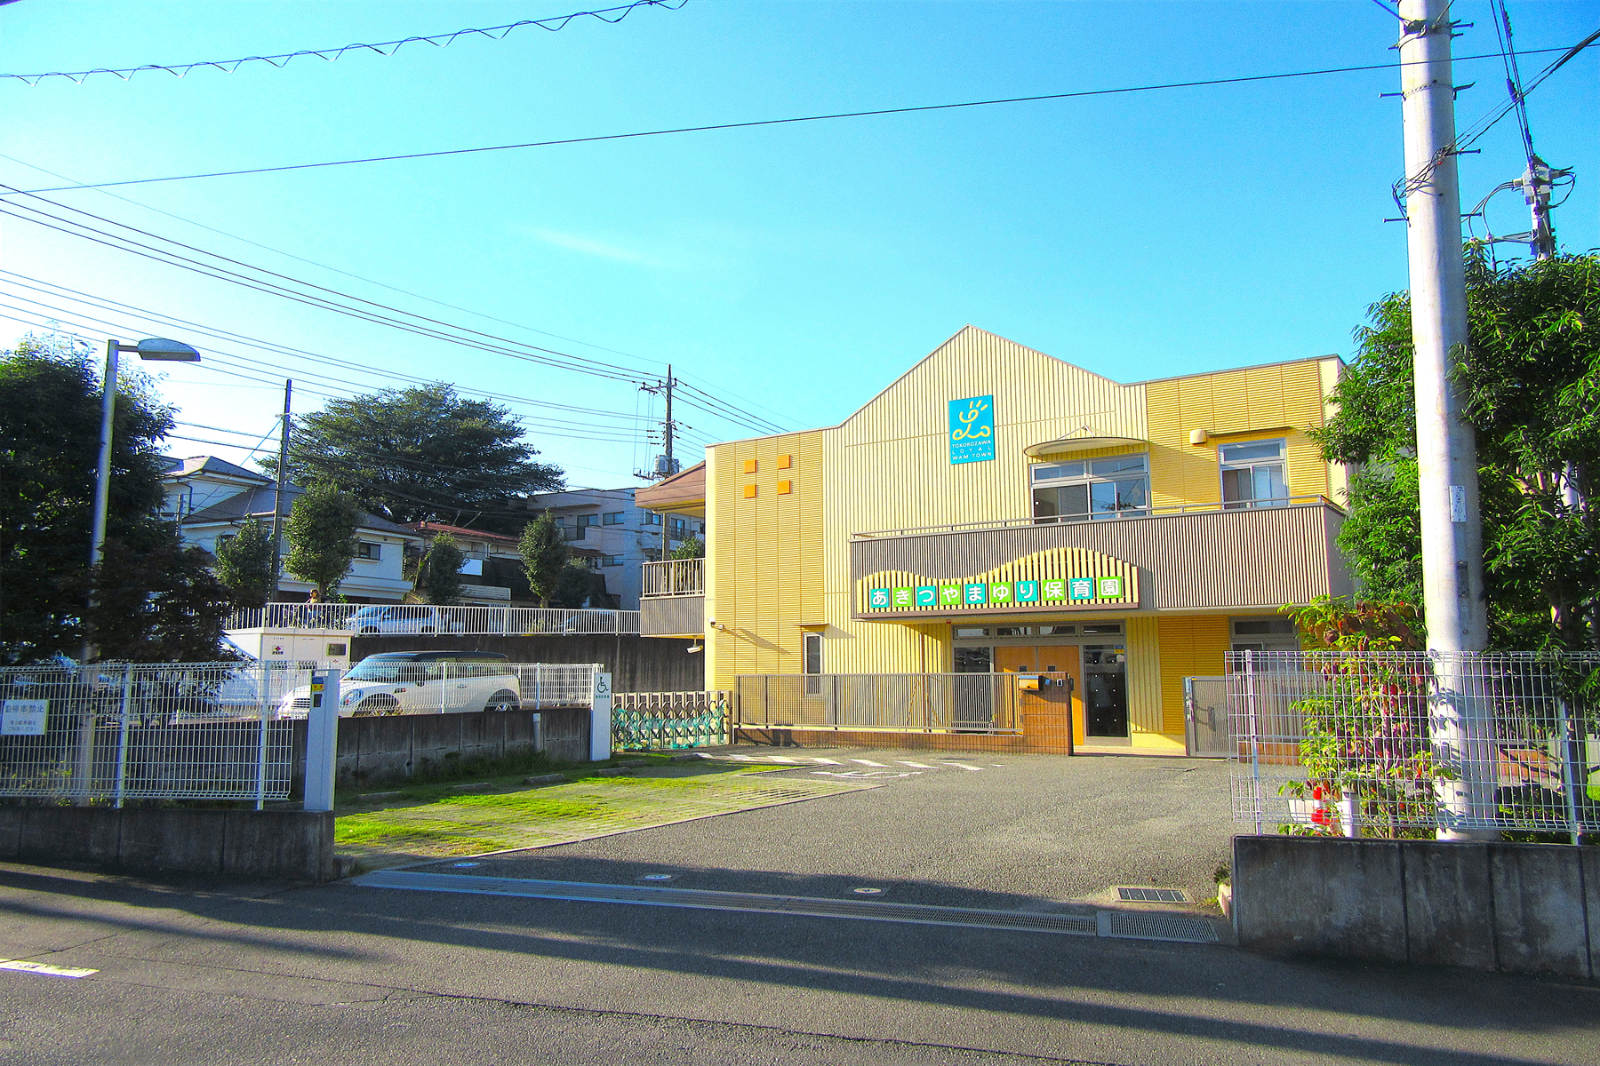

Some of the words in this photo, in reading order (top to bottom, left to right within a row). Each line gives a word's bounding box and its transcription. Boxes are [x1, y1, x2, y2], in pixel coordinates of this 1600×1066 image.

[952, 440, 992, 449] TOKOROZAWA
[952, 446, 992, 455] LOYAL
[872, 578, 1119, 606] あきつやまゆり保育園
